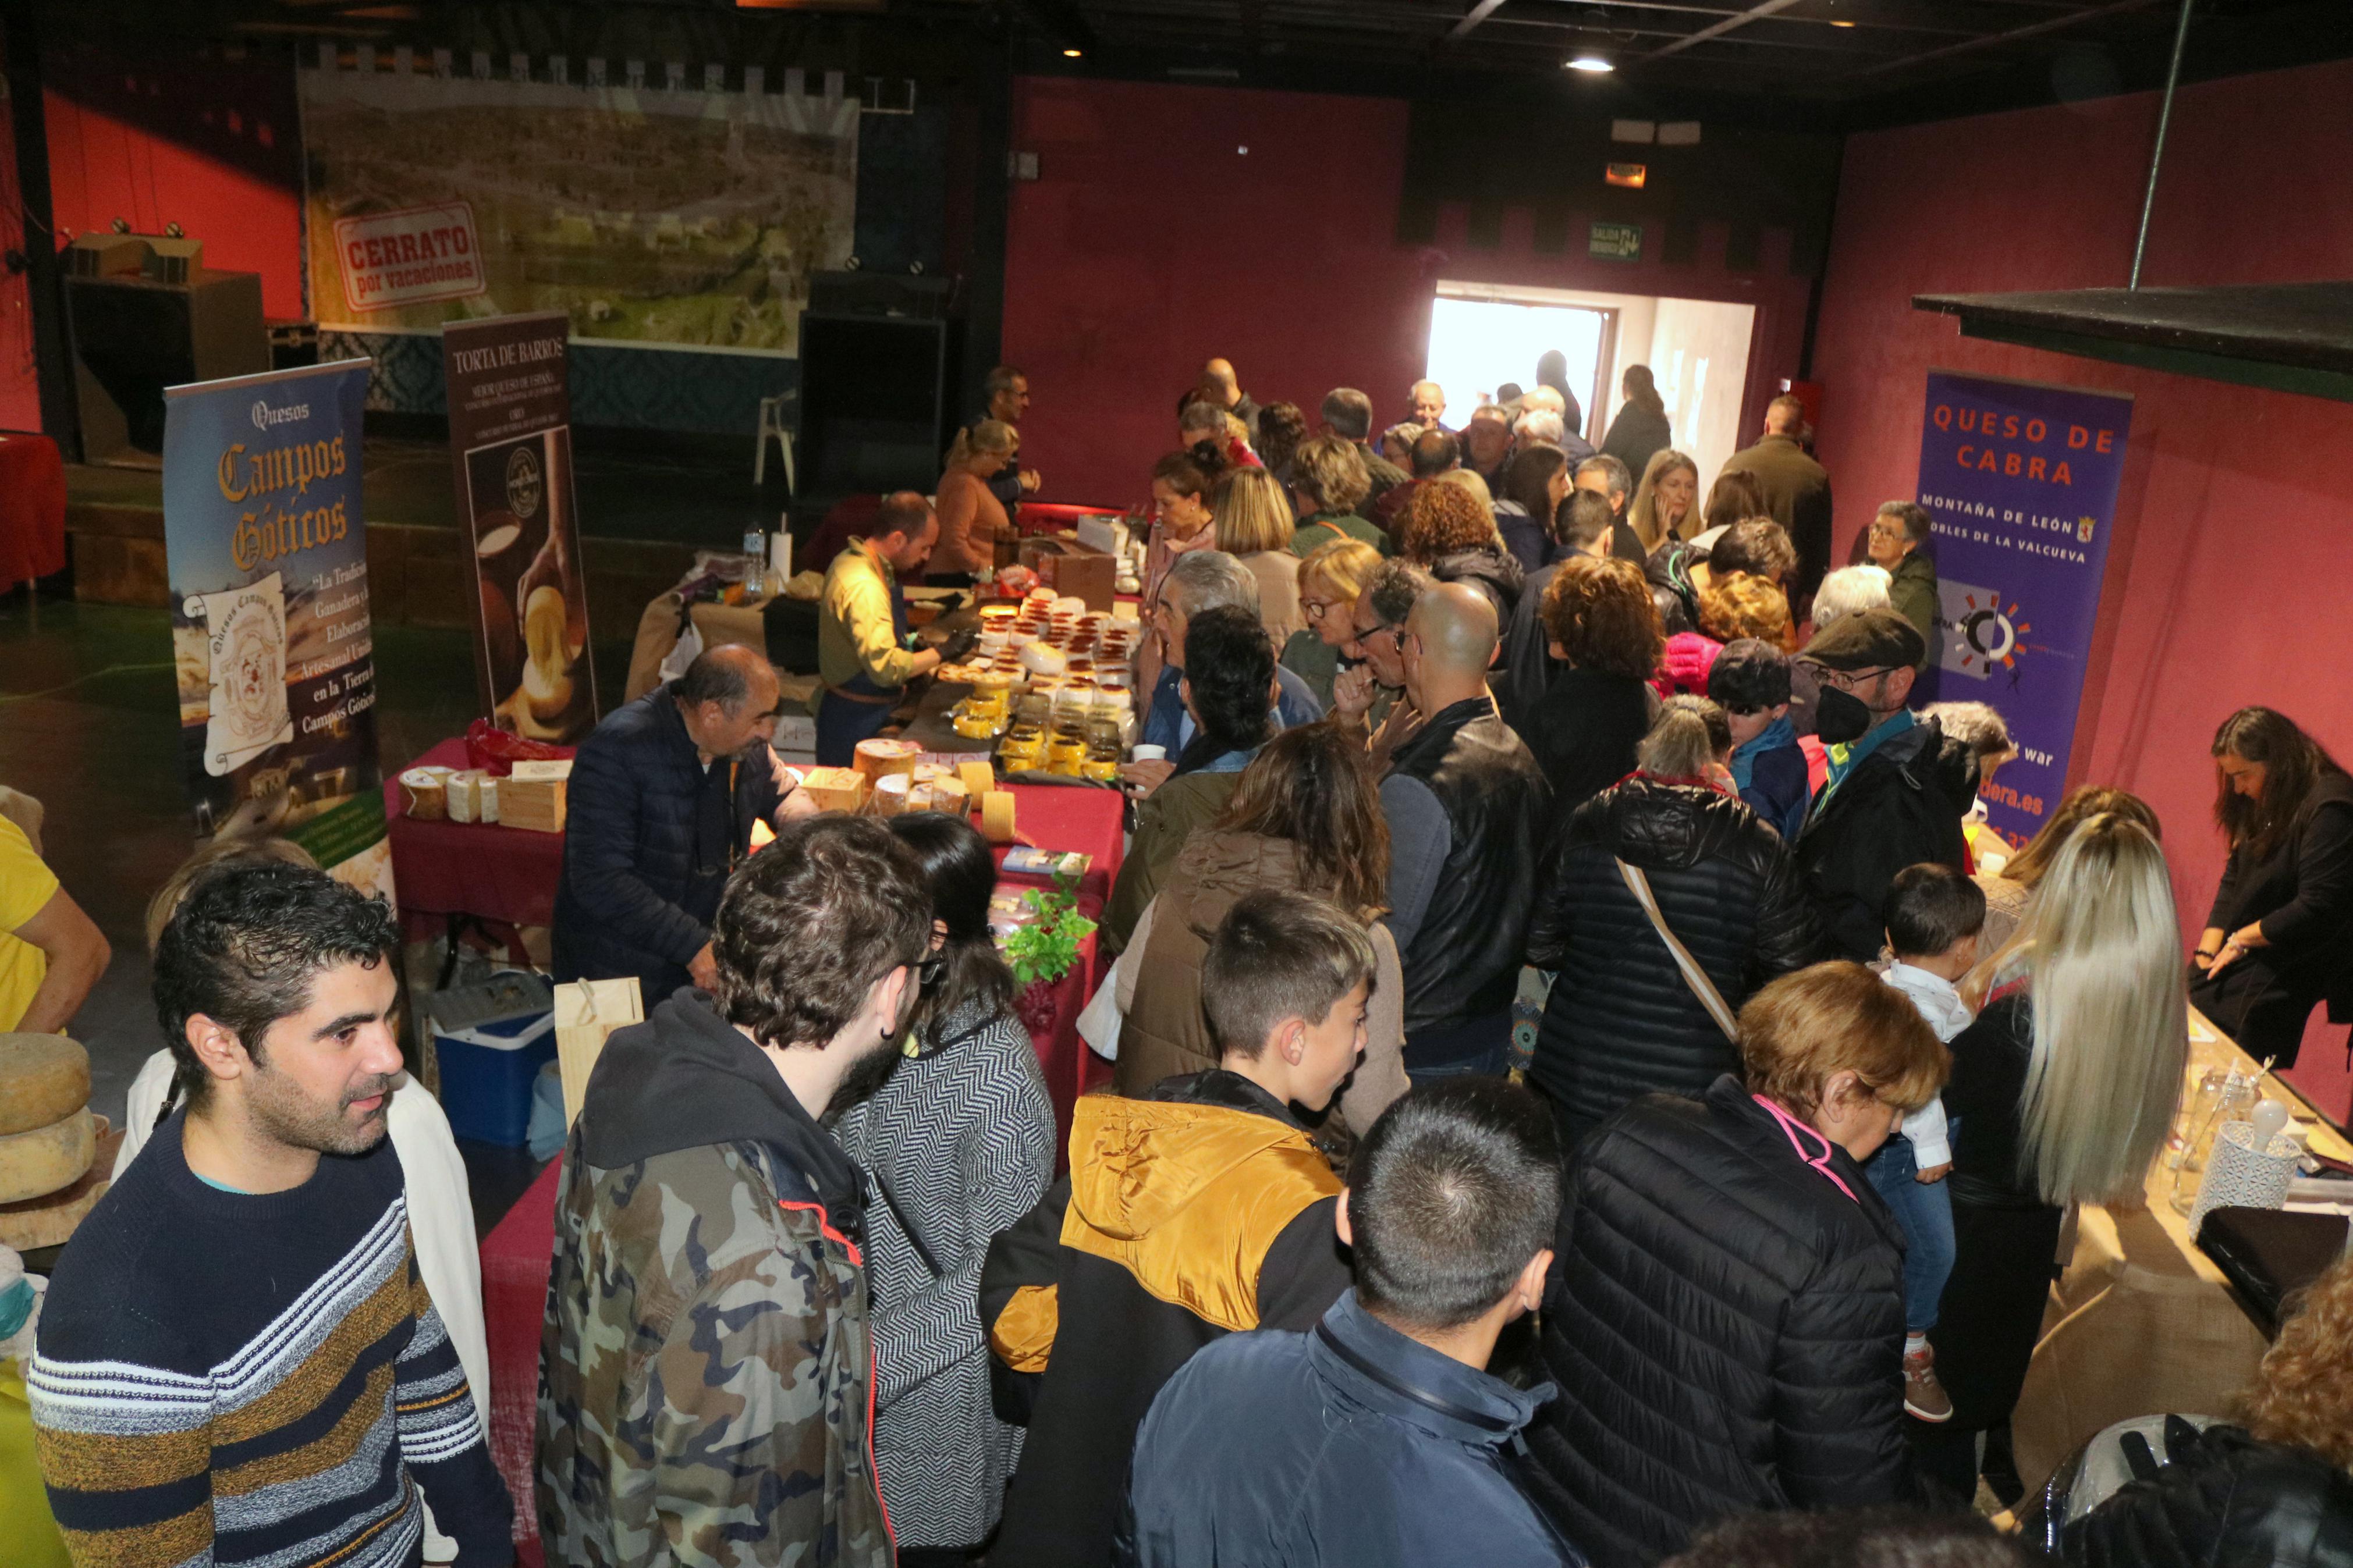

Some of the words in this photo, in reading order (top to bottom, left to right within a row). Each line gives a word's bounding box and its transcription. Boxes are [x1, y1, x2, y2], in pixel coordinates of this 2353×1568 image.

[347, 226, 469, 271] CERRATO
[357, 274, 382, 300] por
[386, 261, 474, 289] vacaciones
[453, 347, 498, 374] TORTA
[498, 344, 516, 367] DE
[519, 337, 563, 363] BARROS
[252, 400, 310, 431] Quesos
[1933, 404, 2047, 443] QUESO
[2068, 425, 2114, 453] DE
[218, 429, 347, 503] Campos
[1957, 445, 2072, 485] CABRA
[1922, 493, 1996, 518] MONTAÑA
[2003, 509, 2023, 524] DE
[2032, 514, 2072, 534] LEÓN
[232, 495, 347, 571] Góticos
[1930, 522, 1967, 539] OBLES
[1974, 531, 1989, 544] DE
[1996, 535, 2011, 549] LA
[2018, 540, 2085, 564] VALCUEVA
[315, 593, 360, 618] Ganadera
[301, 646, 349, 680] Artesanal
[314, 687, 327, 703] en
[328, 680, 340, 696] la
[342, 670, 370, 690] Tierra
[302, 707, 347, 734] Campos
[2025, 747, 2053, 767] war
[1980, 780, 2043, 816] dera.es
